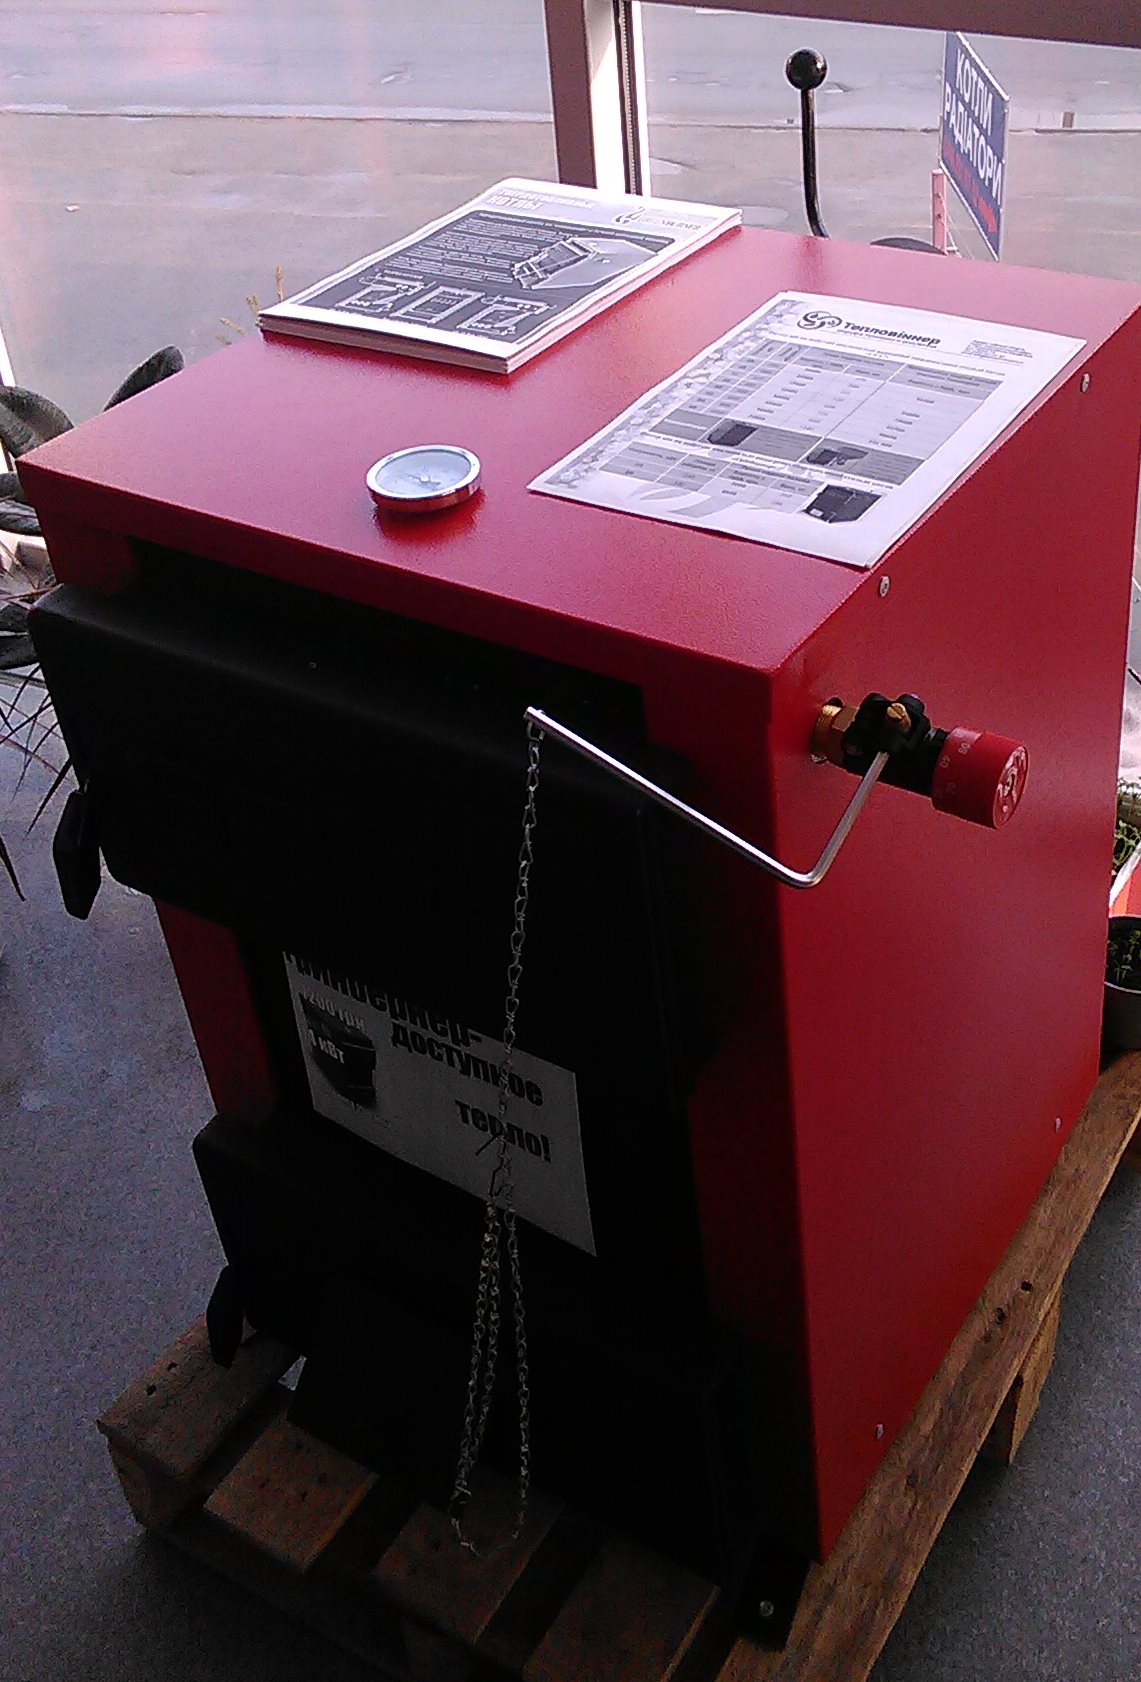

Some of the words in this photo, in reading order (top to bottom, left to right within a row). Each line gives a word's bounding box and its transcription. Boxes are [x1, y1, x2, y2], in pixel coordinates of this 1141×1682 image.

[956, 49, 992, 135] КОТЛИ
[944, 83, 1001, 205] РАДІАТОРИ
[318, 1036, 345, 1064] кВт
